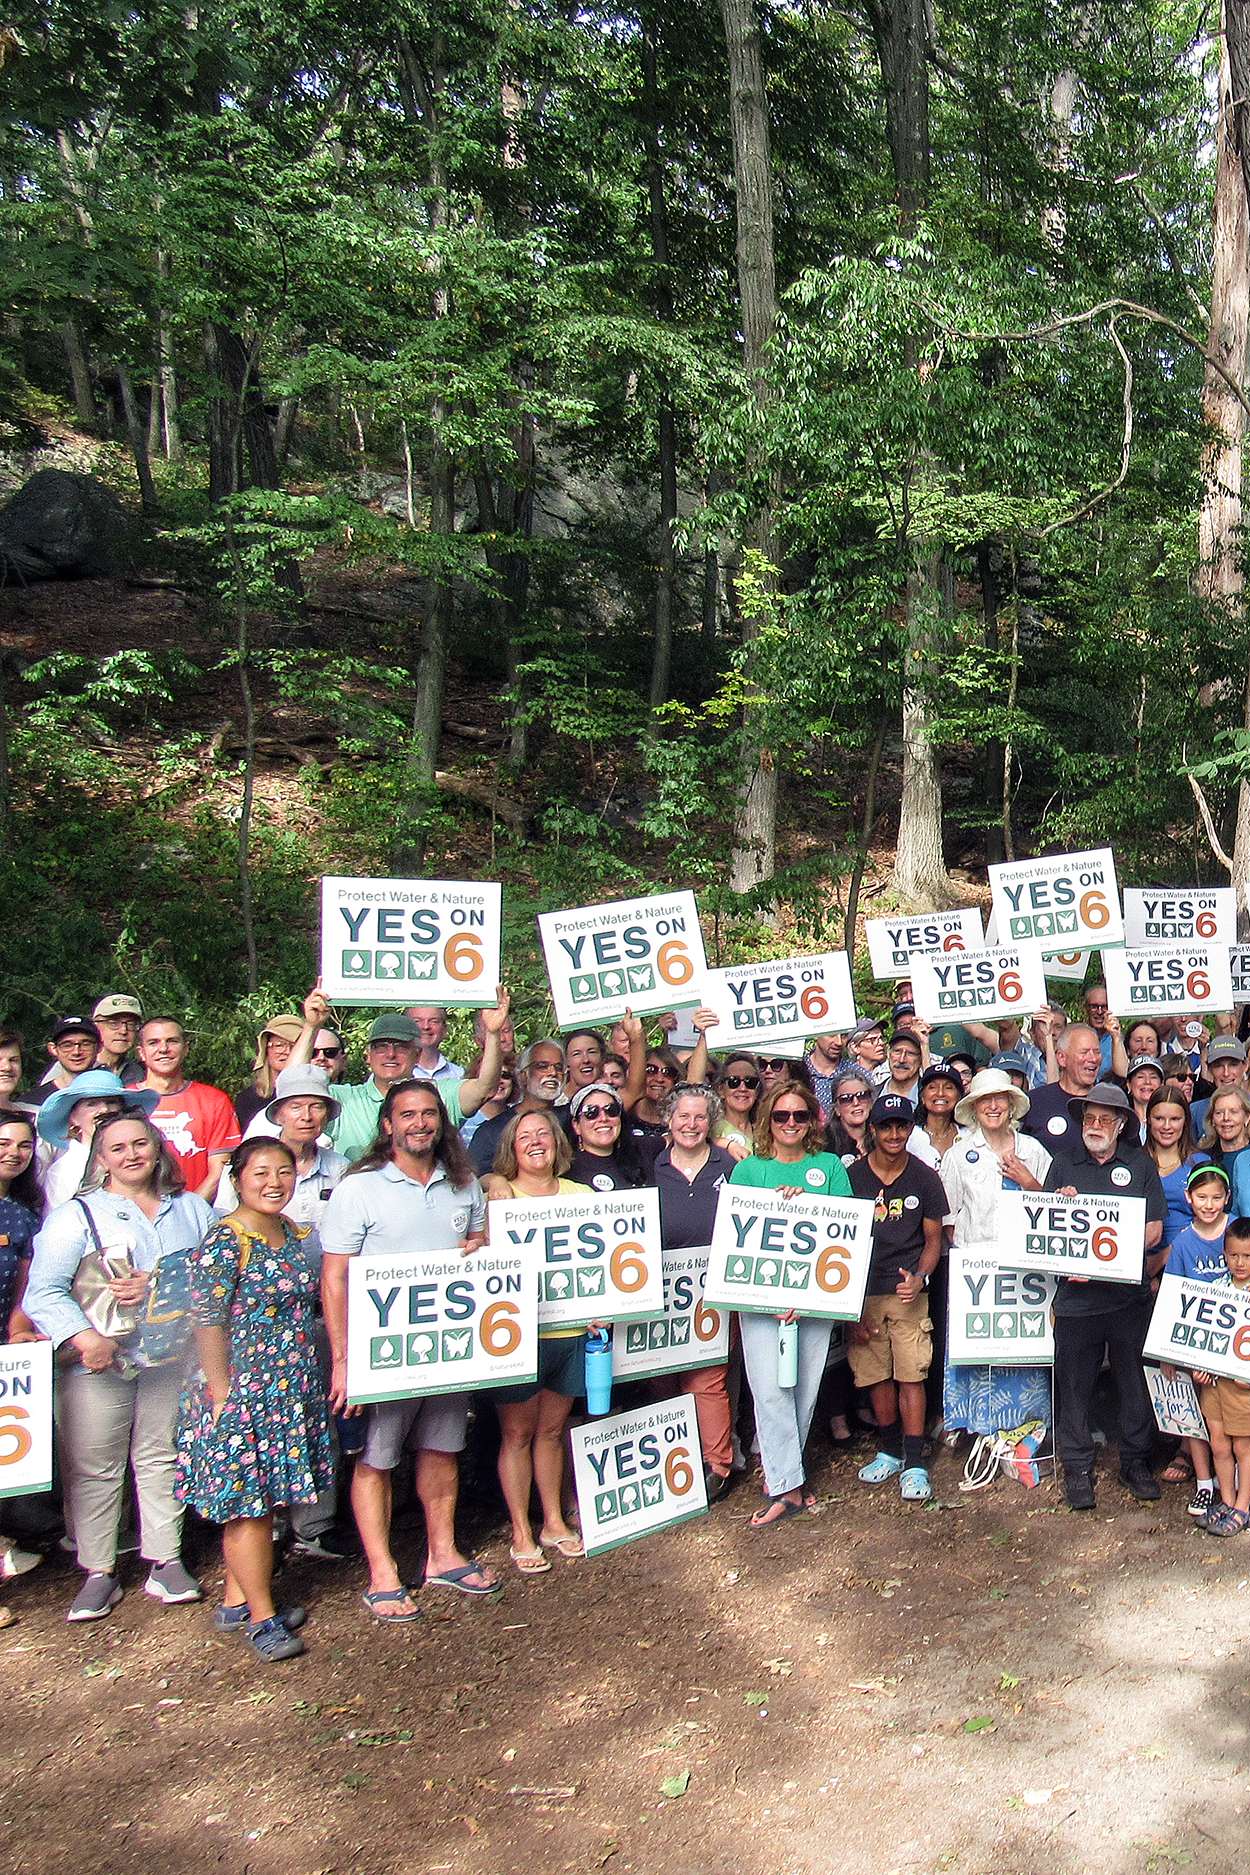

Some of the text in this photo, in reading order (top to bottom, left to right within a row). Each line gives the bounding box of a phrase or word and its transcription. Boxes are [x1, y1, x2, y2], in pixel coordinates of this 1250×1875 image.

[338, 889, 484, 905] Protect Water & Nature
[1002, 871, 1110, 930] YES ON 6
[887, 921, 961, 948] YES ON
[1143, 900, 1217, 939] YES ON 6
[339, 907, 484, 981] YES ON 6
[558, 917, 695, 987] YES ON 6
[724, 960, 822, 980] Protect Water & Nature
[933, 957, 1023, 1003] YES ON 6
[1127, 957, 1210, 1000] YES ON 6
[727, 969, 829, 1020] YES ON 6
[613, 1217, 645, 1236] ON
[1023, 1206, 1120, 1261] YES ON 6
[365, 1259, 521, 1282] Protect Water & Nature
[609, 1241, 649, 1293] 6
[730, 1213, 857, 1292] YES ON 6
[962, 1259, 998, 1269] Protec
[963, 1272, 1048, 1306] YES
[366, 1274, 522, 1357] YES ON 6
[694, 1297, 720, 1341] 6
[1181, 1293, 1239, 1330] YES
[583, 1410, 685, 1448] Protect Water & Nature
[586, 1422, 694, 1496] YES ON 6
